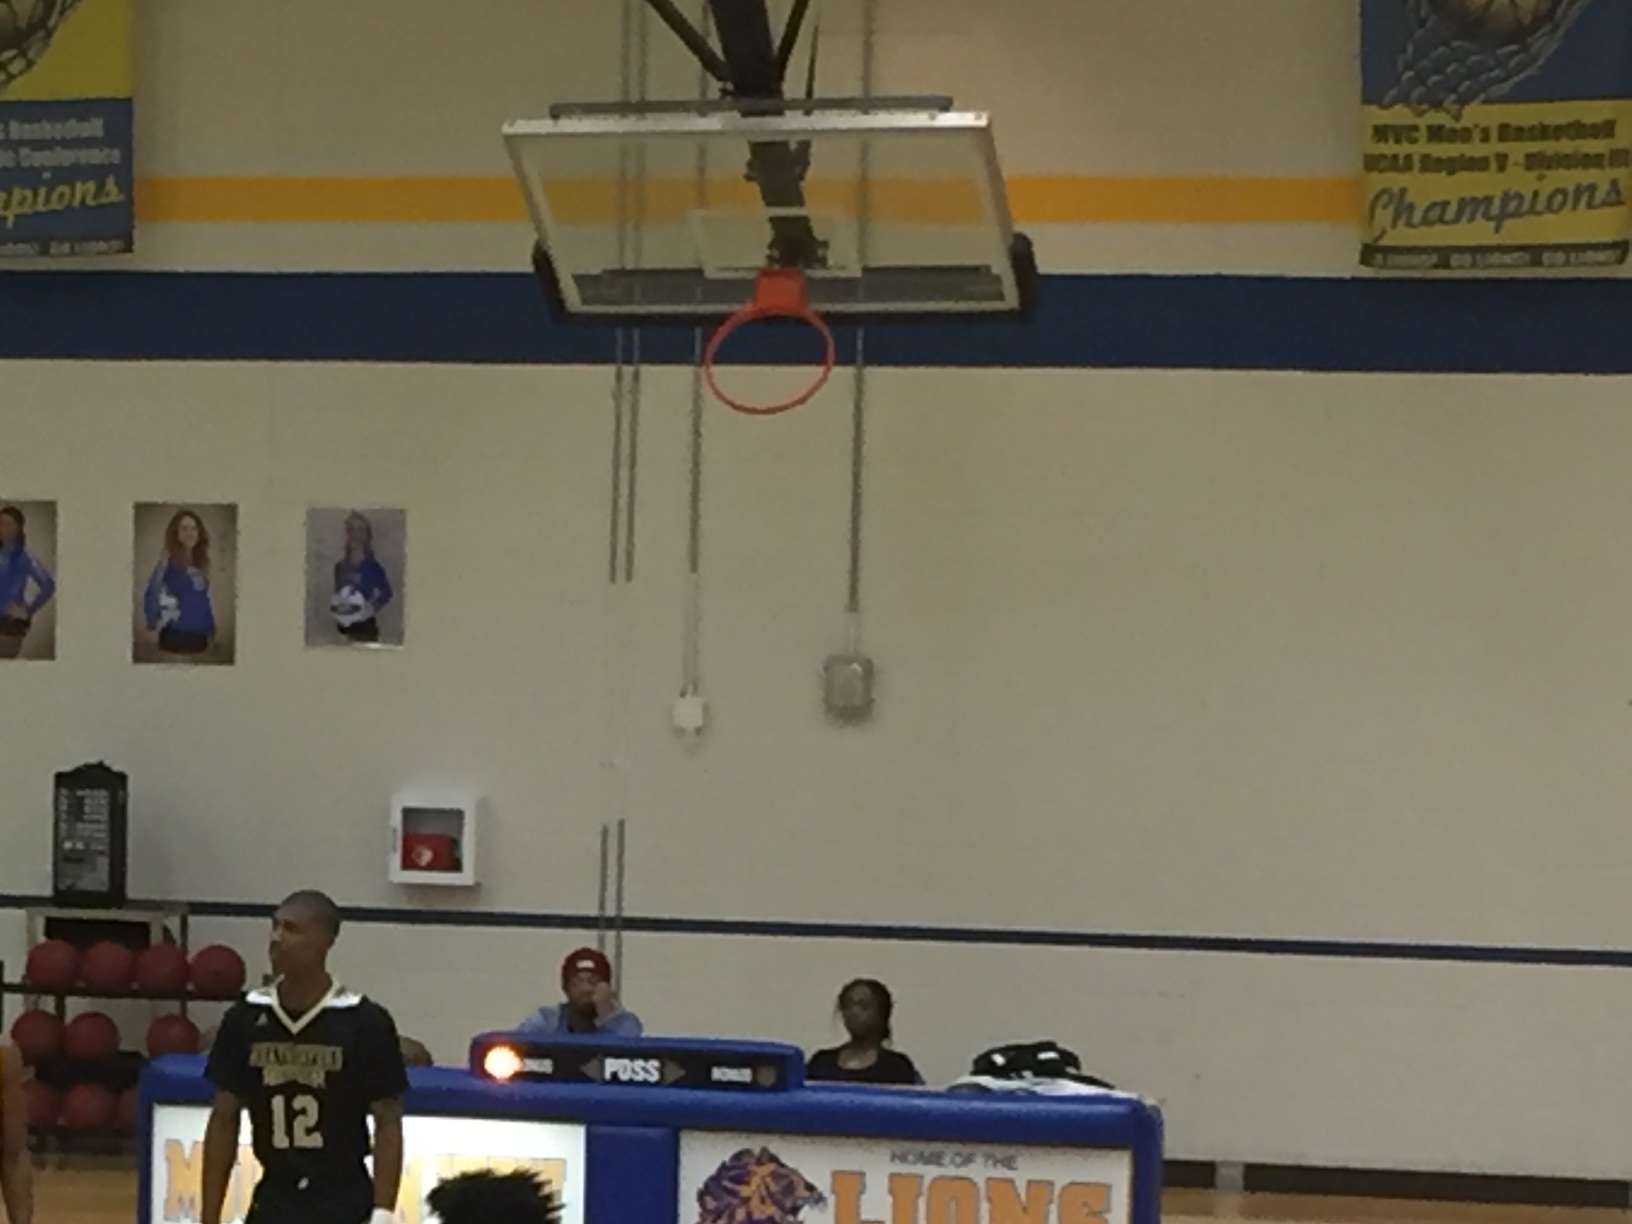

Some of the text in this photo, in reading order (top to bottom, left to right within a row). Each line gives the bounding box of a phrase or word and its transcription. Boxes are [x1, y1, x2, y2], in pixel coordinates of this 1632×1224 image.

[1368, 174, 1627, 243] Champions
[270, 1093, 324, 1150] 12
[889, 1149, 1019, 1171] HOME OF THE
